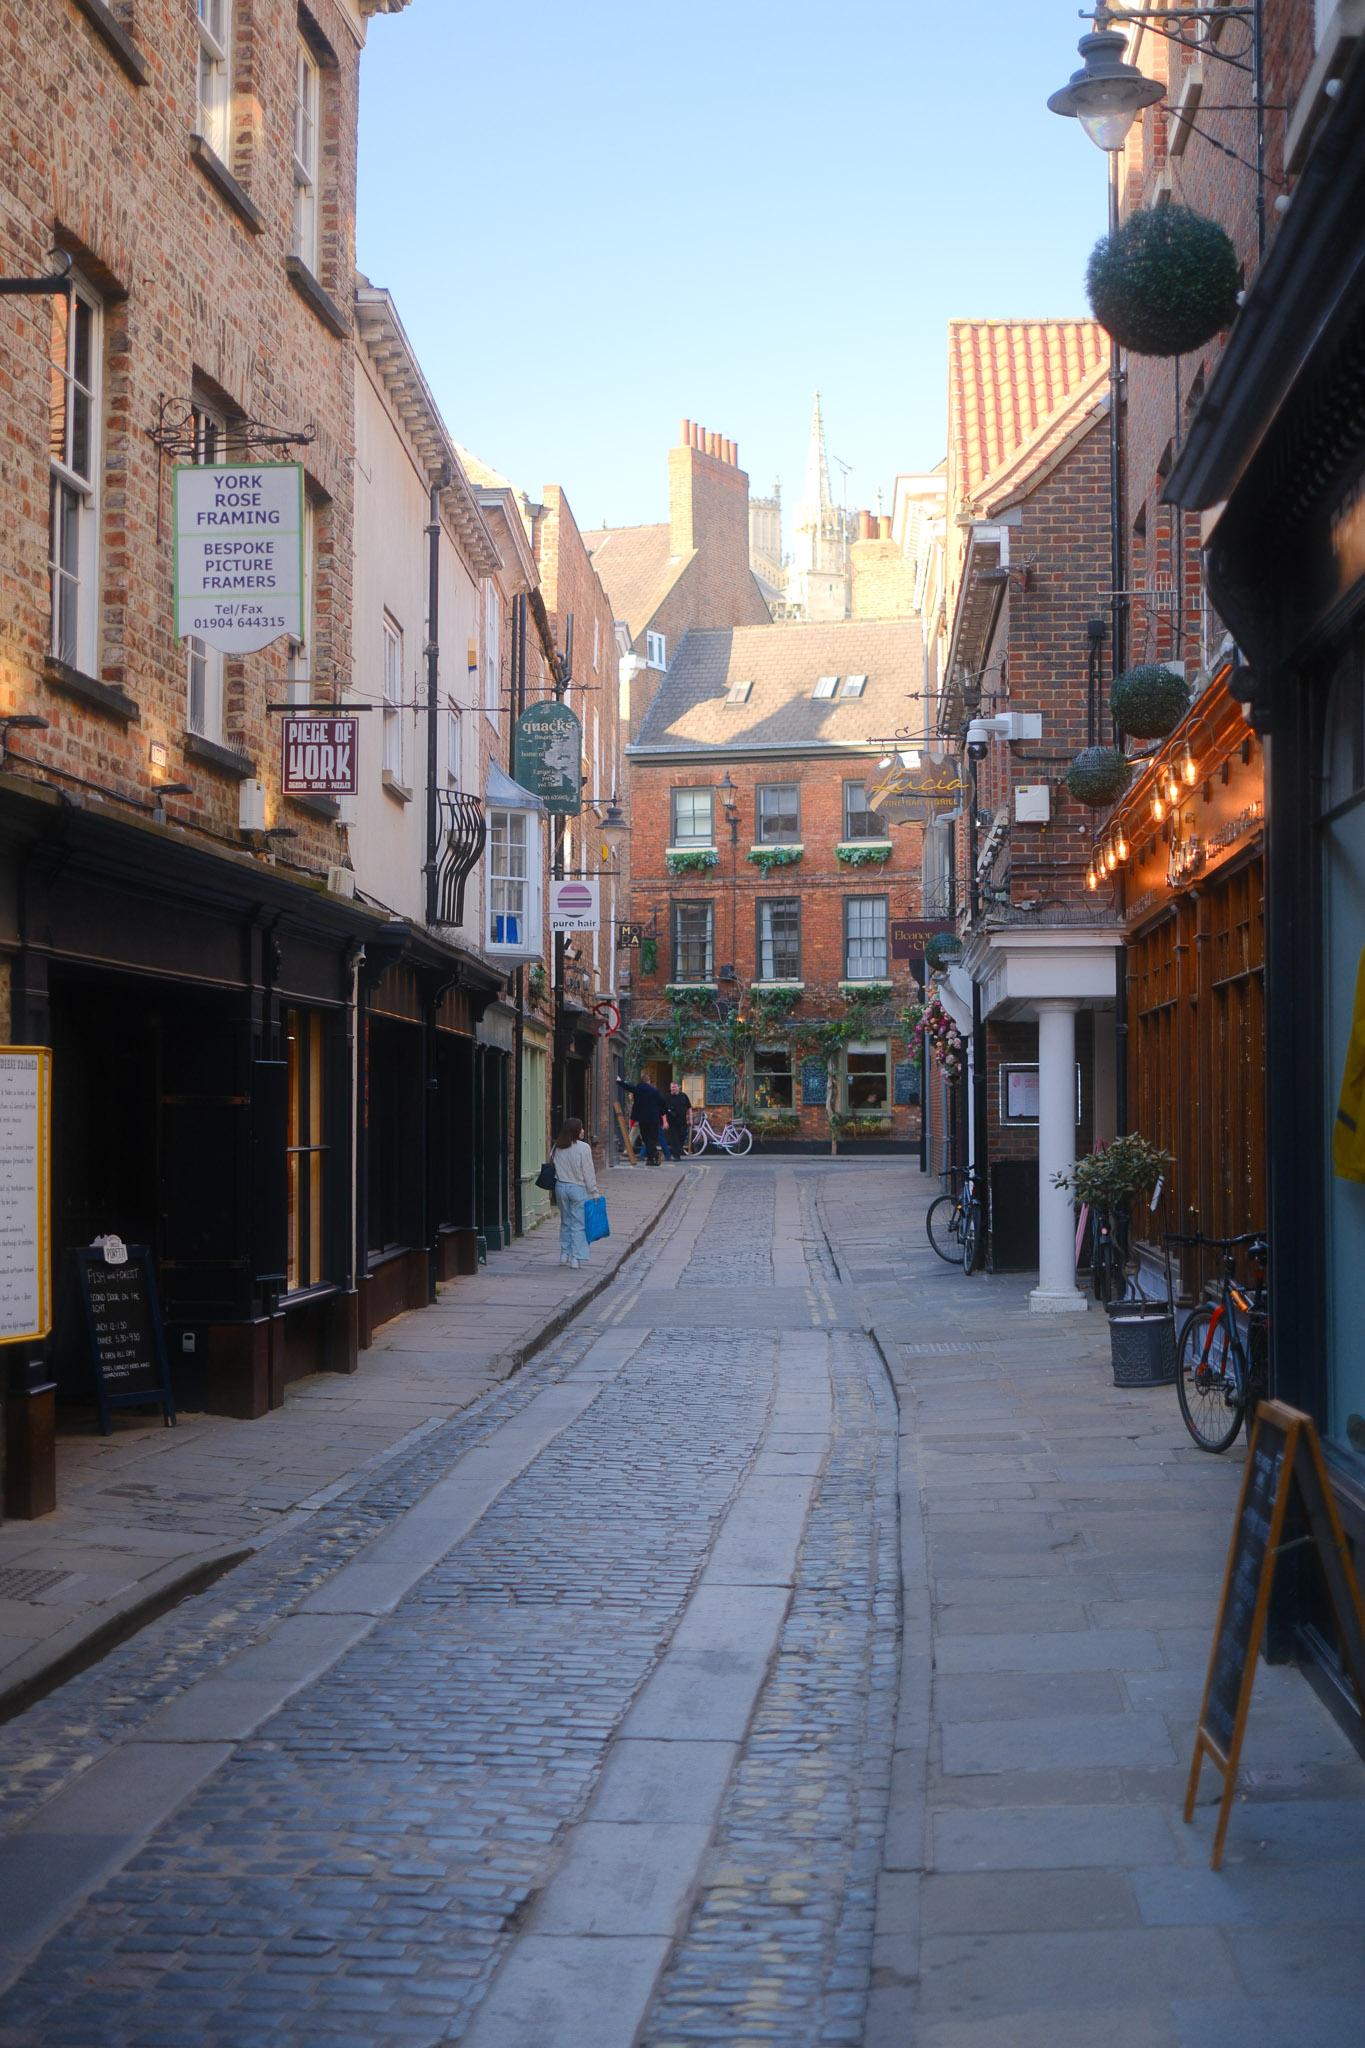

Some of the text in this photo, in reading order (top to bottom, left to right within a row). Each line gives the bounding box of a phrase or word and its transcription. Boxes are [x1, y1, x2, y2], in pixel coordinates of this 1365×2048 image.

[214, 475, 262, 489] YORK
[215, 493, 261, 507] ROSE
[197, 510, 280, 525] FRAMING
[204, 542, 274, 556] BESPOKE
[205, 558, 273, 572] PICTURE
[202, 576, 276, 589] FRAMERS
[214, 604, 263, 617] Tel/Fax
[194, 617, 285, 629] 01904 644315
[289, 723, 352, 743] PIECE OF
[522, 720, 572, 734] quacks
[289, 745, 351, 780] YORK
[871, 763, 969, 795] Lucia
[935, 798, 958, 806] GRILL
[553, 920, 574, 928] pure
[87, 1269, 106, 1284] FISH
[90, 1293, 106, 1302] ECOND
